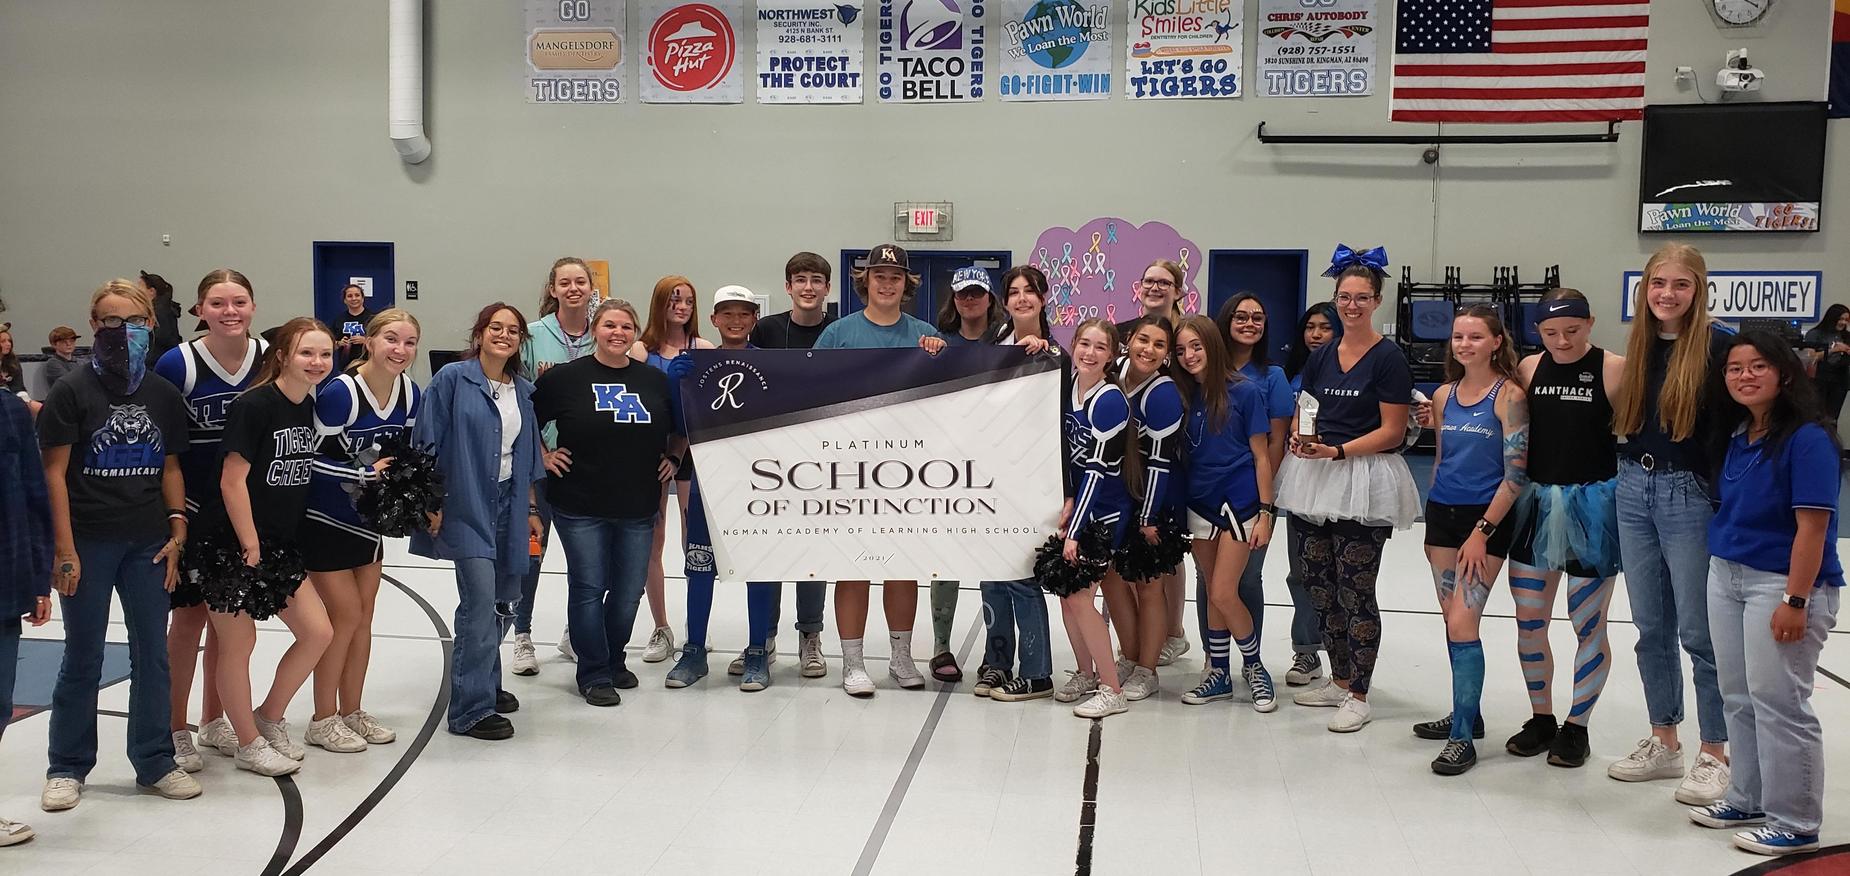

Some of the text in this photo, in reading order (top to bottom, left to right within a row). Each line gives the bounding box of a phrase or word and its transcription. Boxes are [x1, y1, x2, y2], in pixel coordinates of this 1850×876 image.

[559, 0, 590, 21] GO
[758, 9, 835, 20] NORTHWEST
[1267, 11, 1369, 22] CHRIS' AUTOBODY
[1004, 4, 1109, 45] Pawn World
[1141, 15, 1203, 38] Smiles
[536, 41, 615, 50] MANGELSDORF
[778, 35, 842, 43] 928-681-3111
[1008, 31, 1108, 60] We Loan the Most
[664, 40, 714, 64] Pizza
[879, 0, 892, 99] GO TIGER
[1277, 46, 1356, 55] (928) 757-1551
[673, 56, 711, 76] Hut
[769, 56, 849, 72] PROTECT
[897, 57, 965, 77] TACO
[970, 25, 984, 98] TIGERS
[1140, 59, 1228, 75] LET'S GO
[532, 78, 619, 101] TIGERS
[760, 72, 860, 88] THE COURT
[902, 79, 964, 100] BELL
[1131, 74, 1237, 98] TIGERS
[1264, 69, 1368, 95] TIGERS
[914, 211, 934, 226] EXIT
[1647, 202, 1743, 225] Pawn World
[1773, 203, 1795, 217] GO
[1666, 221, 1692, 231] Loan
[1694, 219, 1712, 227] the
[1713, 217, 1741, 226] Most
[1755, 215, 1817, 231] TIGERS!
[880, 248, 898, 263] KA
[1723, 281, 1811, 313] JOURNEY
[342, 321, 366, 337] KA
[699, 359, 769, 391] JOSTENS RENAISSANCE
[711, 372, 745, 411] R
[1324, 388, 1360, 397] TIGERS
[1534, 386, 1593, 397] KANTHACK
[591, 383, 652, 424] KA
[1459, 422, 1495, 439] Academy
[274, 427, 316, 458] TIGER
[822, 439, 925, 450] PLATINUM
[267, 459, 313, 486] CHEE
[750, 458, 994, 491] SCHOOL
[747, 497, 998, 516] OF DISTINCTION
[723, 526, 1038, 536] NGMAN ACADEMY OF LEARNING HIGH SCHOOL
[686, 562, 712, 572] TIGERS
